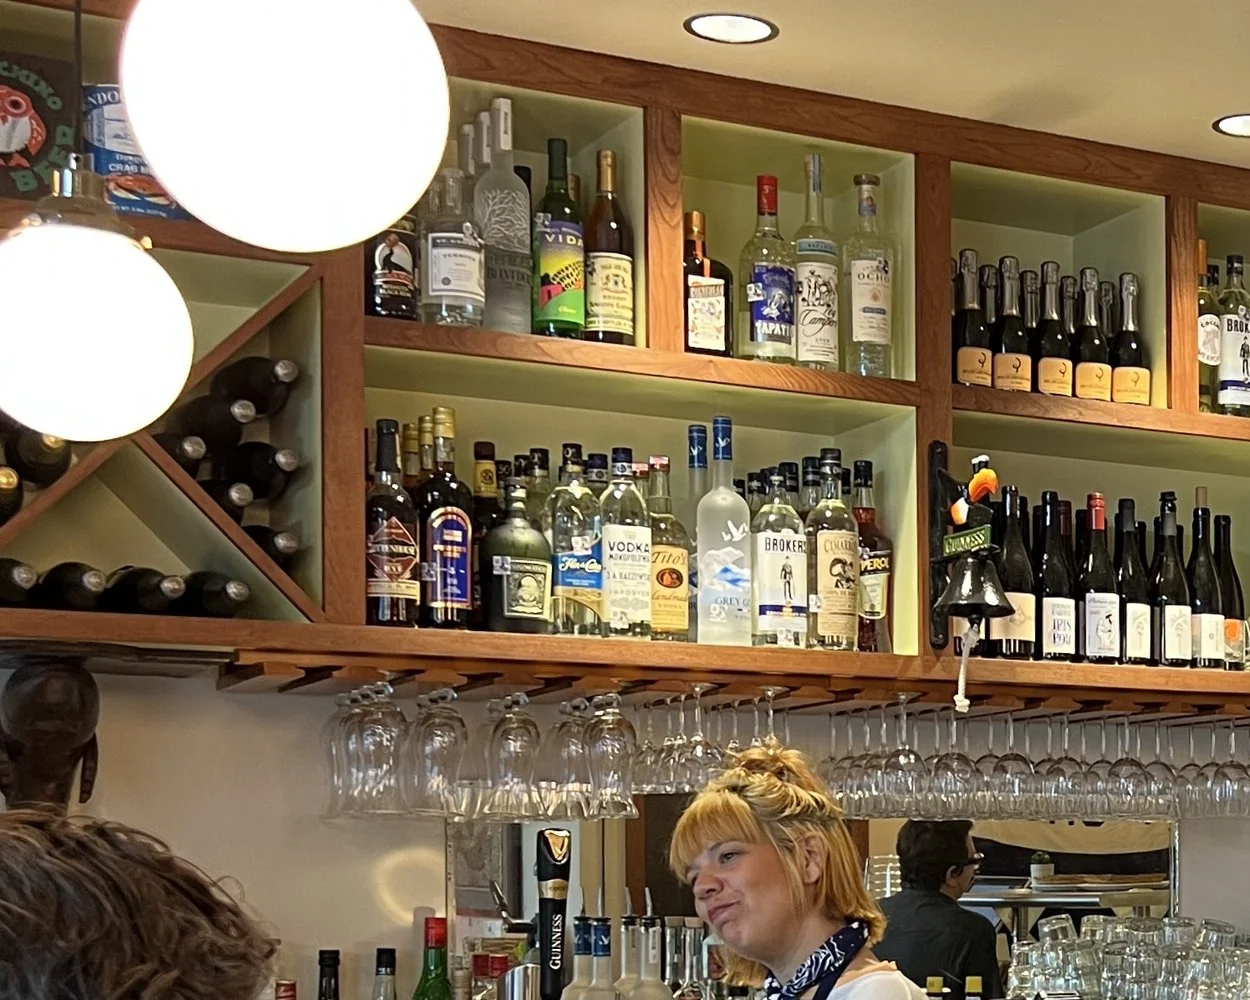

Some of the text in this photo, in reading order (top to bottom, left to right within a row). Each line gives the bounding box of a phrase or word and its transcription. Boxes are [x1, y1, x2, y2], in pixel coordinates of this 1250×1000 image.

[108, 163, 139, 173] CRAB
[608, 540, 650, 554] VODKA
[651, 550, 687, 565] Tito's
[860, 557, 890, 571] PEROL
[714, 596, 740, 607] GREY
[548, 913, 564, 971] GUINNESS
